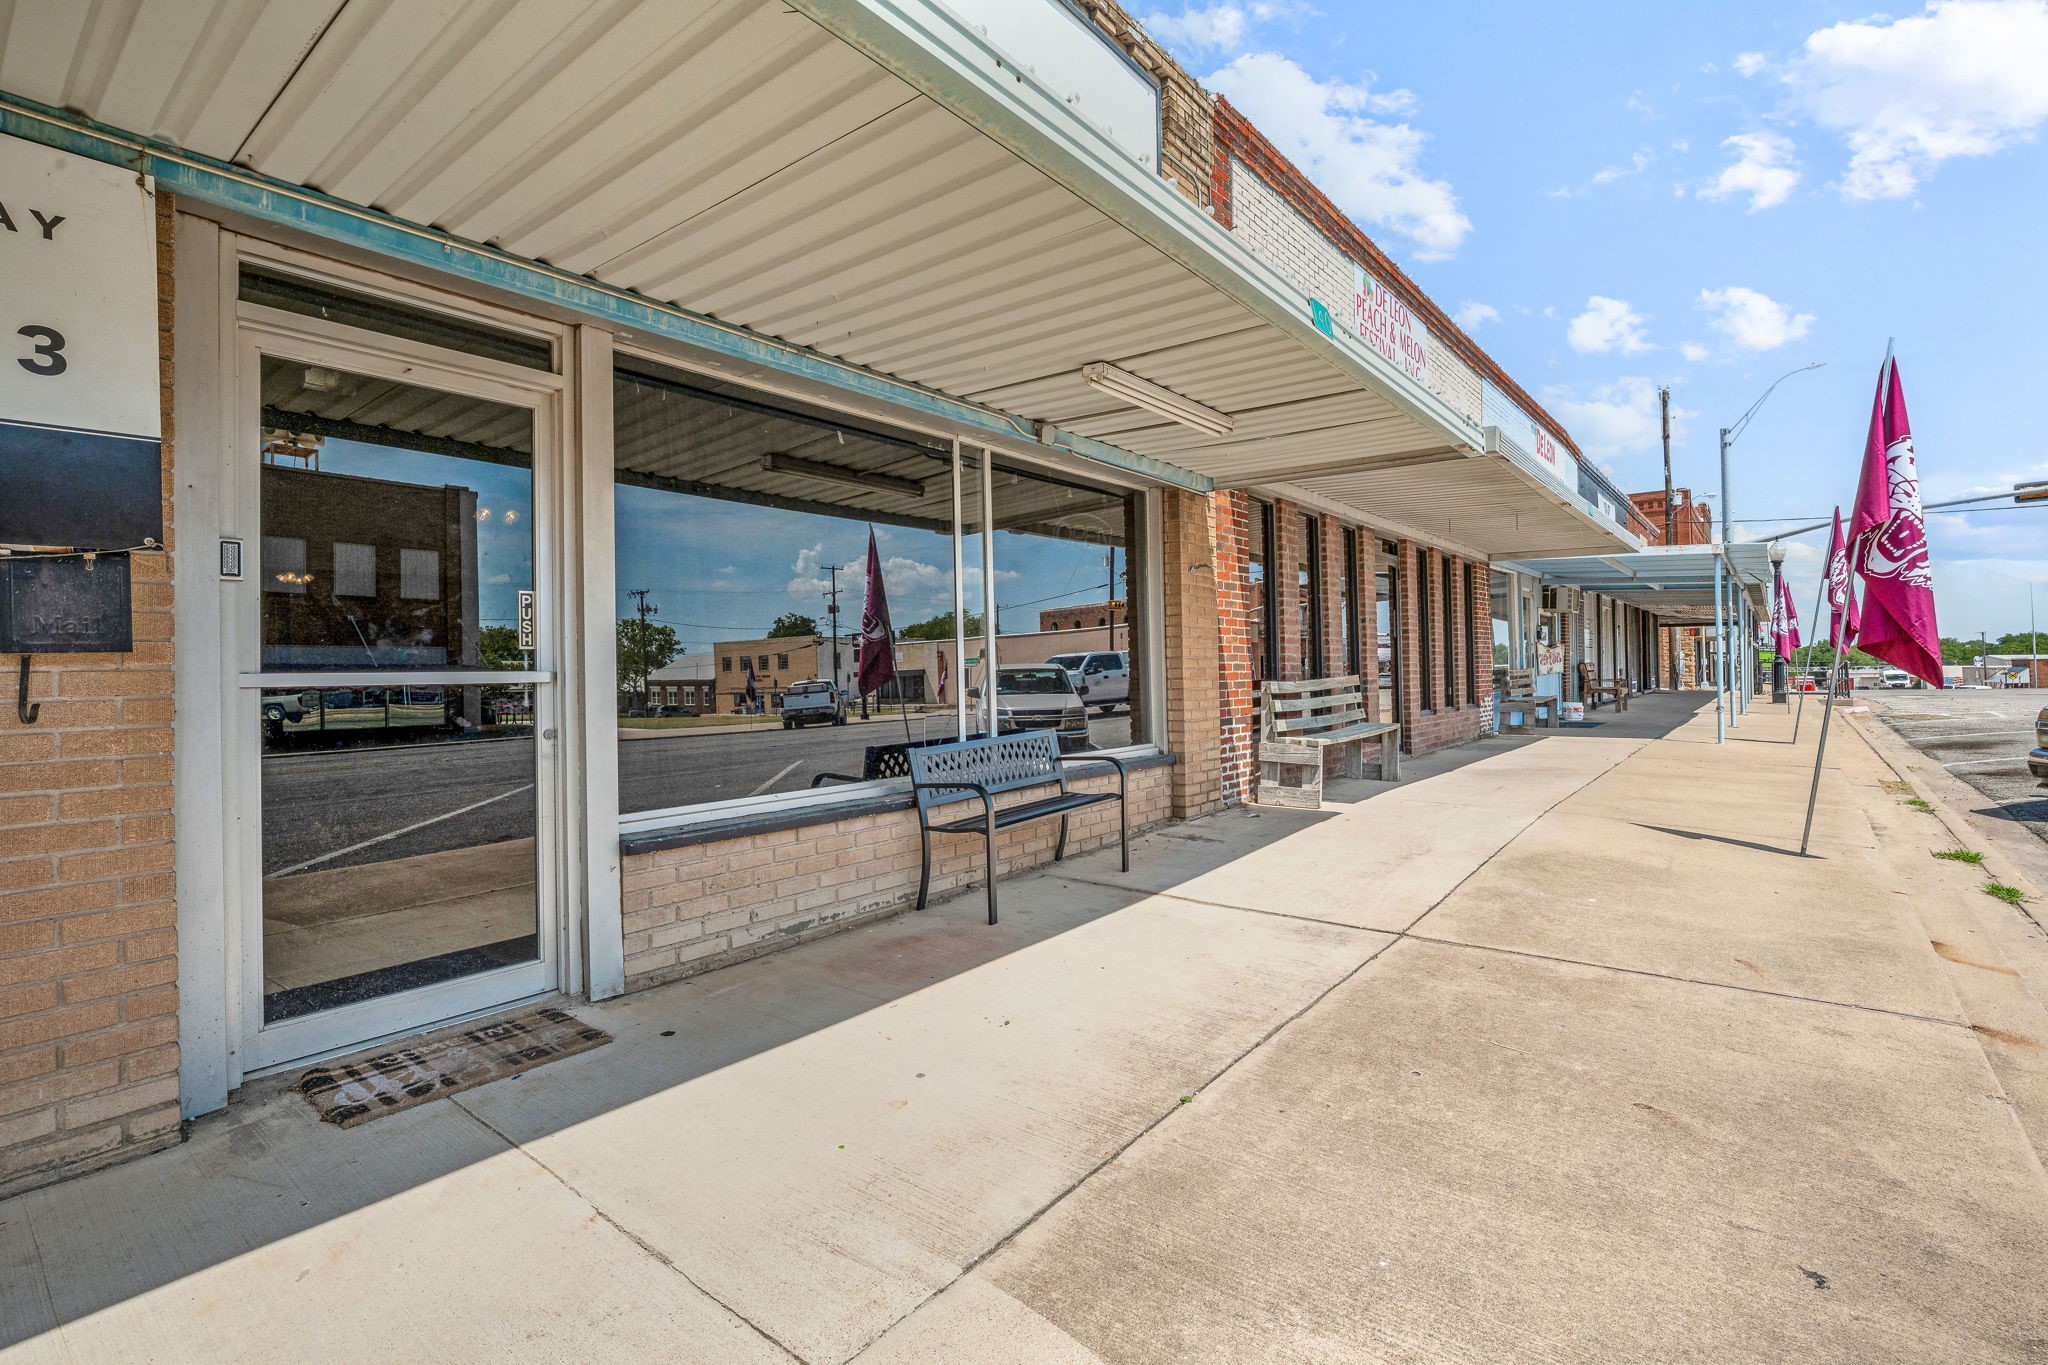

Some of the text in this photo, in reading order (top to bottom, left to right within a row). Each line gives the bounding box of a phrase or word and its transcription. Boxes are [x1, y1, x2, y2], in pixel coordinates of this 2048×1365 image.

[1356, 293, 1426, 368] PEACH & MELON
[1375, 283, 1412, 334] DE LEON
[16, 324, 68, 377] 3
[32, 614, 98, 635] Mail
[521, 594, 532, 646] PUSH
